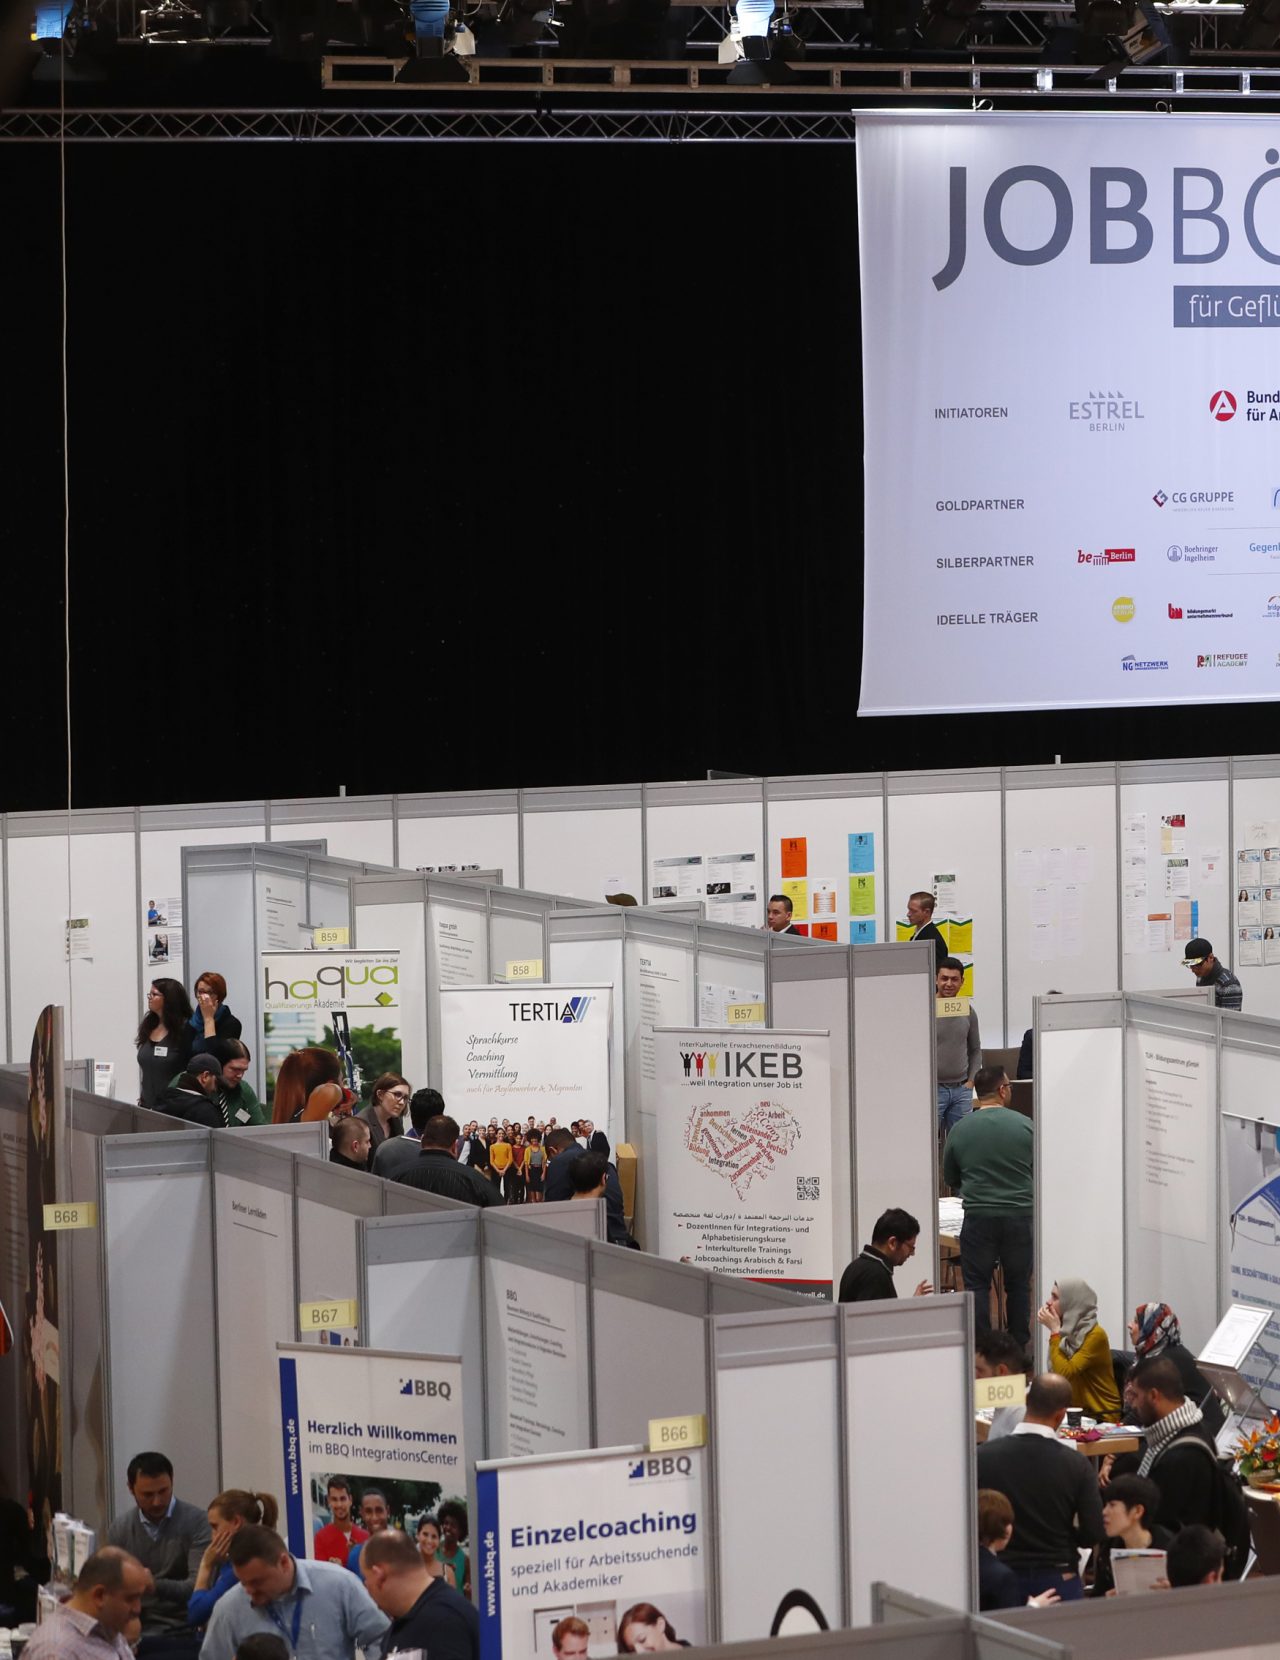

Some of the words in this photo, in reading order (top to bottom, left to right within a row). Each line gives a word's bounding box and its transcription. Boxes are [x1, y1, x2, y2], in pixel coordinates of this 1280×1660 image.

[1189, 294, 1223, 323] für
[934, 407, 1008, 419] INITIATOREN
[1069, 401, 1145, 420] ESTREL
[1247, 408, 1266, 421] für
[1089, 423, 1125, 431] BERLIN
[1172, 492, 1187, 503] CG
[1190, 491, 1234, 503] GRUPPE
[936, 498, 1025, 512] GOLDPARTNER
[1110, 552, 1133, 560] Berlin
[1184, 545, 1218, 554] Boehringer
[936, 555, 1034, 569] SILBERPARTNER
[1184, 554, 1215, 563] Ingelheim
[937, 613, 986, 625] IDEELLE
[990, 610, 1038, 624] TRÄGER
[322, 933, 337, 942] B59
[513, 966, 529, 975] B58
[265, 966, 398, 999] haqua
[314, 1000, 344, 1008] Akademie
[944, 1002, 961, 1012] B52
[509, 1002, 576, 1021] TERTIA
[734, 1009, 752, 1019] B57
[466, 1032, 519, 1050] Sprachkurse
[679, 1041, 728, 1049] InterKulturelle
[730, 1042, 801, 1051] ErwachsenenBildung
[466, 1050, 505, 1066] Coaching
[725, 1052, 803, 1079] IKEB
[468, 1067, 519, 1083] Vermittlung
[708, 1080, 751, 1089] Integration
[700, 1110, 731, 1118] ankommen
[768, 1111, 786, 1119] Arbeit
[731, 1125, 748, 1140] lernen
[740, 1124, 773, 1140] miteinander
[766, 1141, 788, 1155] Deutsch
[708, 1156, 739, 1169] Integration
[54, 1210, 78, 1224] B68
[686, 1223, 731, 1231] DozentInnen
[747, 1225, 793, 1233] Integrations-
[795, 1225, 809, 1233] und
[702, 1234, 786, 1243] Alphabetisierungskurse
[705, 1245, 756, 1253] Interkulturelle
[694, 1255, 742, 1264] Jobcoachings
[745, 1256, 775, 1264] Arabisch
[713, 1267, 784, 1275] Dolmetscherdienste
[312, 1309, 338, 1324] B67
[414, 1380, 451, 1400] BBQ
[988, 1384, 1014, 1401] B60
[307, 1420, 363, 1437] Herzlich
[367, 1425, 457, 1445] Willkommen
[661, 1426, 688, 1442] B66
[287, 1418, 298, 1495] www.bbq.de
[309, 1442, 322, 1454] im
[326, 1443, 349, 1457] BBQ
[352, 1446, 458, 1466] IntegrationsCenter
[648, 1456, 692, 1477] BBQ
[511, 1511, 697, 1548] Einzelcoaching
[511, 1558, 561, 1577] speziell
[566, 1555, 584, 1570] für
[589, 1544, 698, 1567] Arbeitssuchende
[484, 1531, 496, 1617] www.bbq.de
[512, 1583, 538, 1597] und
[543, 1574, 623, 1593] Akademiker
